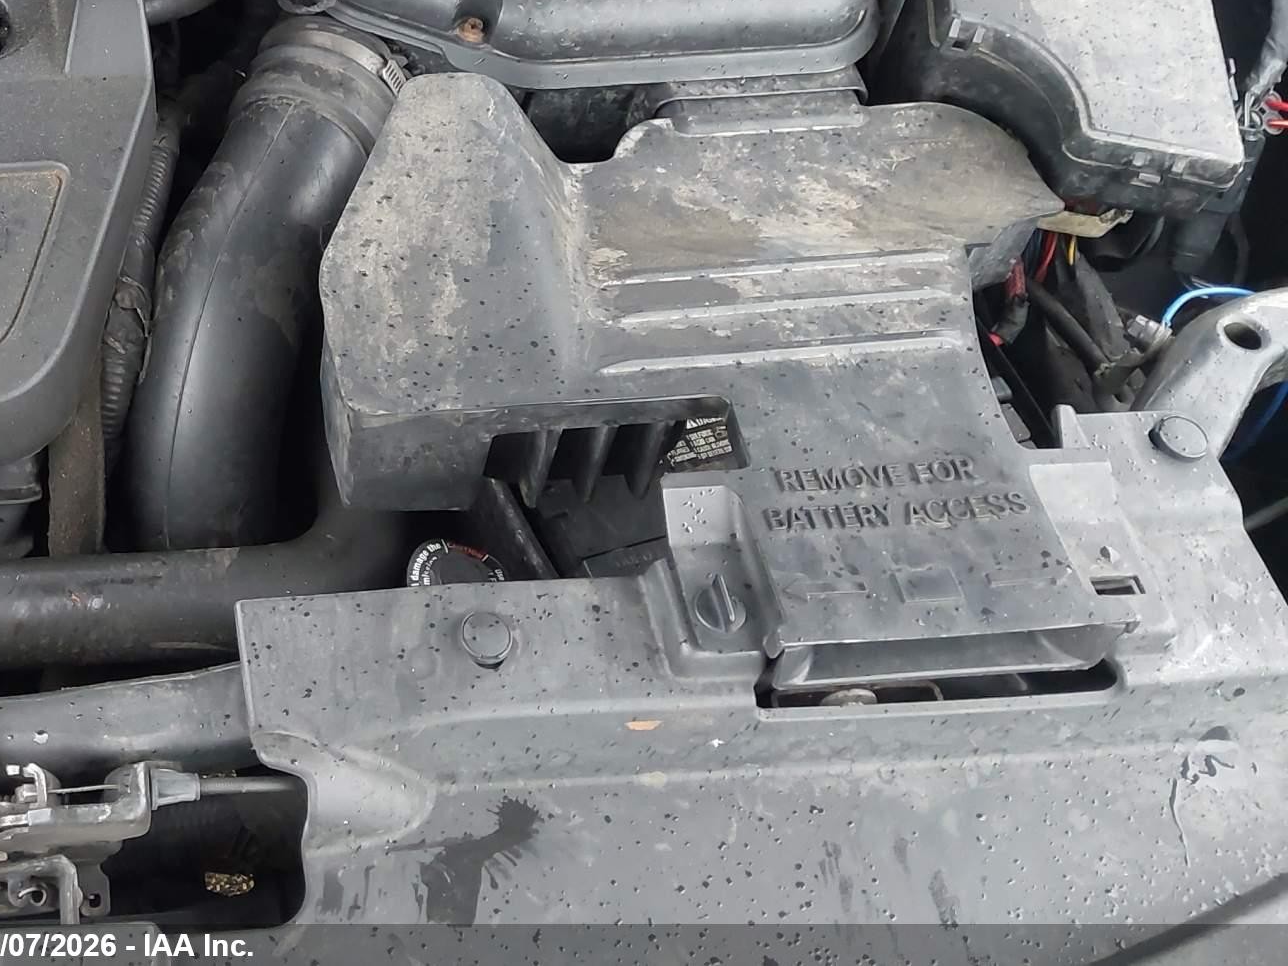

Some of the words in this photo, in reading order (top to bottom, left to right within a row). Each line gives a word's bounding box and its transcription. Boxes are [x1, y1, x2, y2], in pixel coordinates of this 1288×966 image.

[775, 462, 906, 492] REMOVE
[909, 456, 977, 485] FOR
[763, 502, 891, 531] BATTERY
[905, 491, 1030, 529] ACCESS
[410, 549, 430, 581] damage
[426, 542, 442, 553] the
